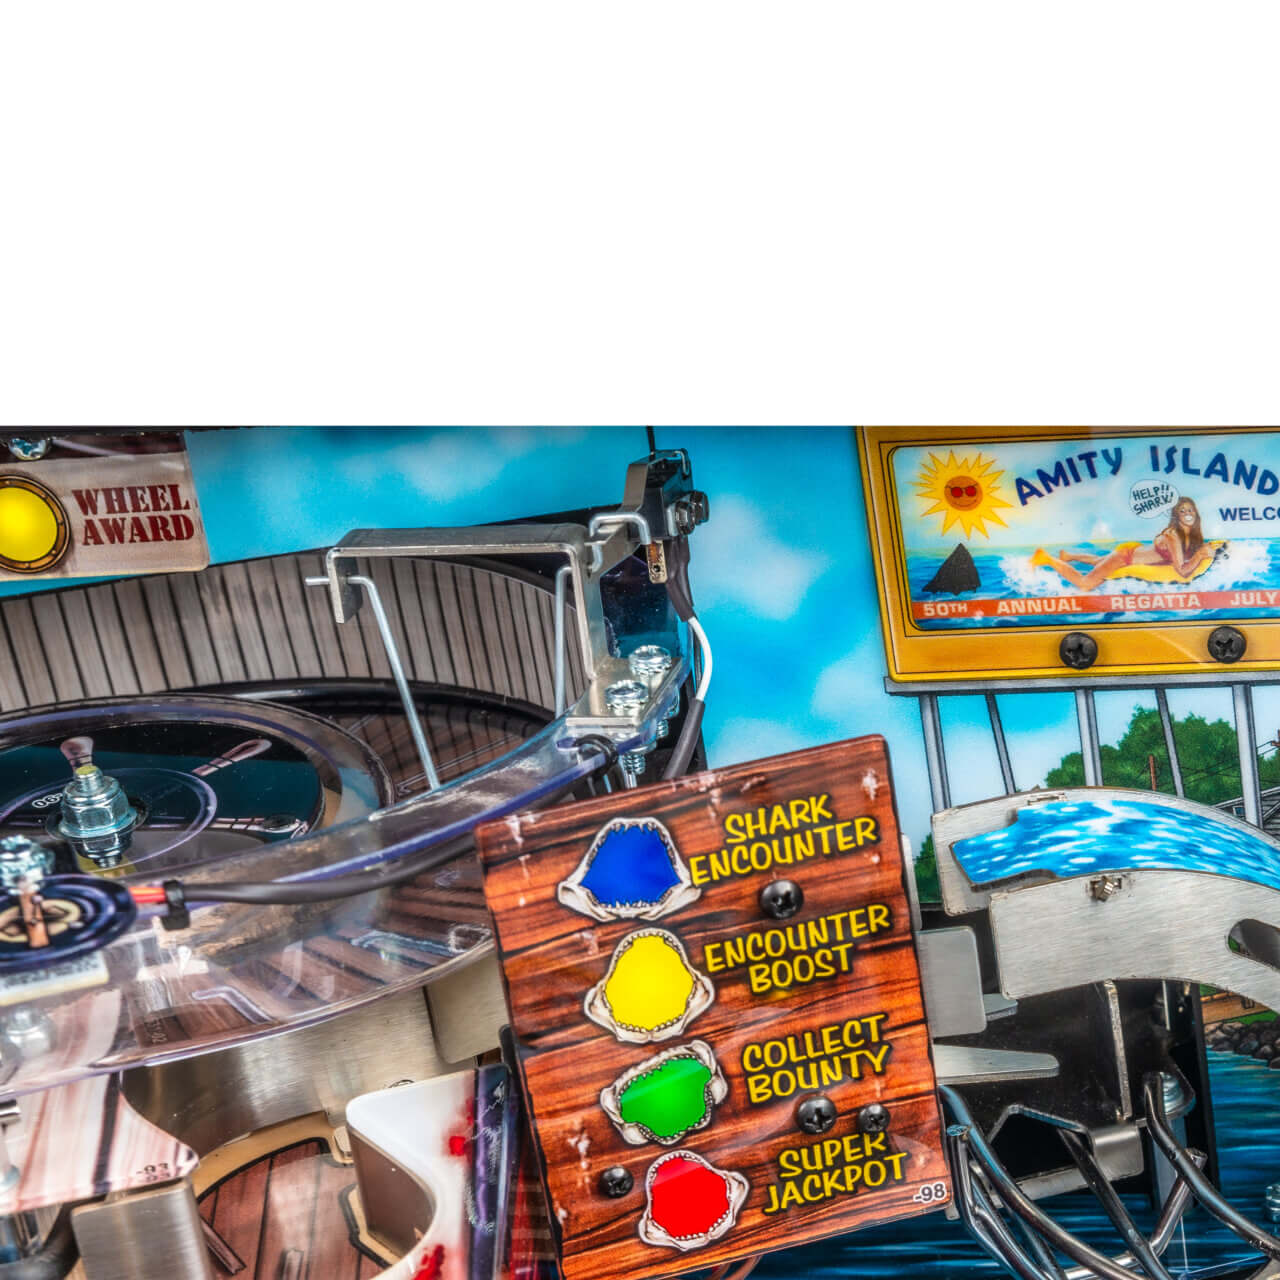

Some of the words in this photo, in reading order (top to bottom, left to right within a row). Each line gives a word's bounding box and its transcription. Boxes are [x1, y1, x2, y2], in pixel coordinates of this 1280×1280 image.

[71, 483, 191, 516] WHEEL
[1014, 446, 1122, 507] AMITY
[1149, 445, 1280, 496] ISLAND
[1132, 484, 1169, 501] HELP!!
[81, 513, 195, 546] AWARD
[922, 602, 968, 617] 50TH
[997, 598, 1082, 615] ANNUAL
[1111, 594, 1200, 612] REGATTA
[1230, 591, 1279, 606] JULY
[723, 794, 835, 845] SHARK
[689, 816, 877, 886] ENCOUNTER
[704, 904, 892, 973] ENCOUNTER
[748, 943, 854, 994] BOOST
[742, 1014, 887, 1074] COLLECT
[747, 1045, 891, 1103] BOUNTY
[779, 1132, 887, 1178] SUPER
[764, 1152, 908, 1213] JACKPOT
[914, 1183, 946, 1203] -98
